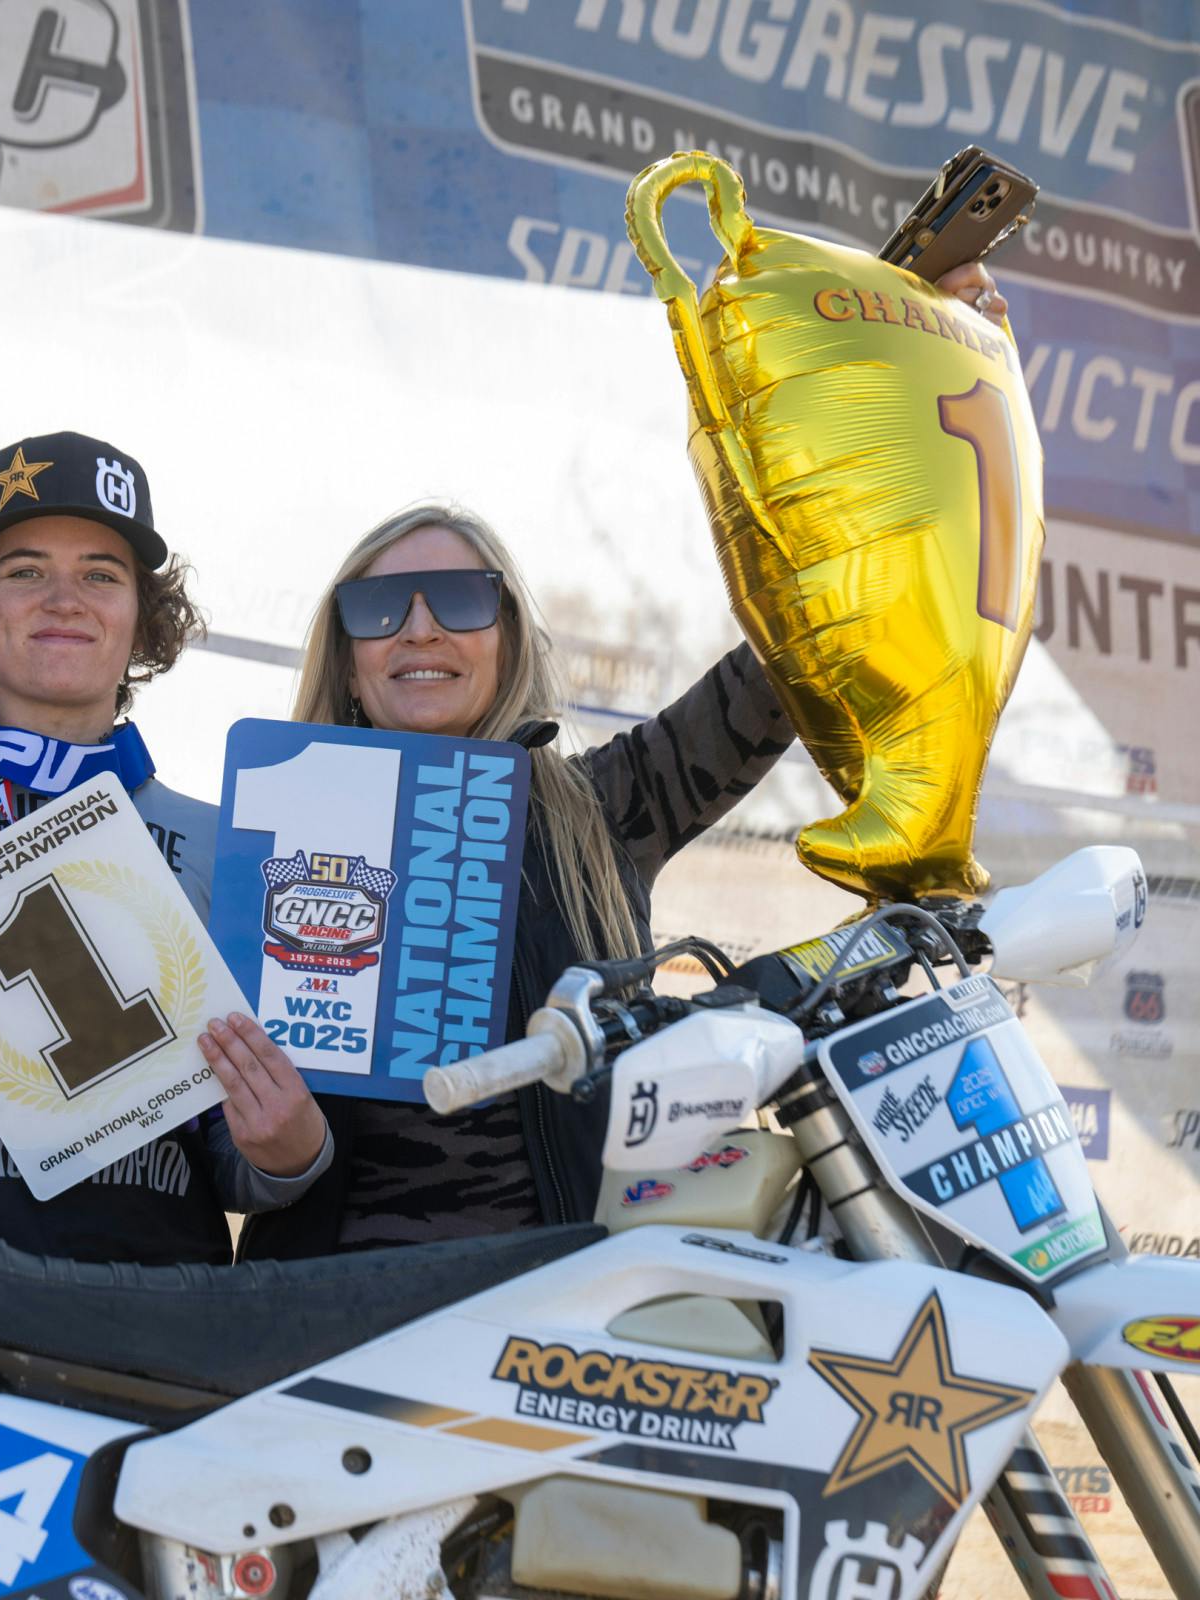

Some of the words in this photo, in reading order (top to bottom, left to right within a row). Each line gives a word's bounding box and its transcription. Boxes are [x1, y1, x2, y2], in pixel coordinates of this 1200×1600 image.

[503, 0, 1148, 173] OGRESSIVE
[509, 87, 655, 152] GRAND
[1022, 217, 1187, 291] COUNTRY
[16, 789, 111, 847] NATIONAL
[275, 897, 377, 931] GNCC
[293, 886, 358, 901] PROGRESSIVE
[388, 750, 466, 1080] NATIONAL
[298, 924, 353, 940] RACING
[290, 953, 315, 963] 1975
[326, 957, 352, 967] 2025
[284, 995, 353, 1022] WXC
[297, 977, 339, 993] AMA
[263, 1018, 368, 1054] 2025
[39, 1140, 84, 1173] GRAND
[84, 1106, 148, 1148] NATIONAL
[147, 1080, 192, 1110] CROSS
[137, 1110, 165, 1129] WXC
[927, 1104, 1073, 1201] CHAMPION
[498, 1337, 774, 1422] ROCKSTAR
[518, 1391, 637, 1435] ENERGY
[640, 1411, 737, 1449] DRINK
